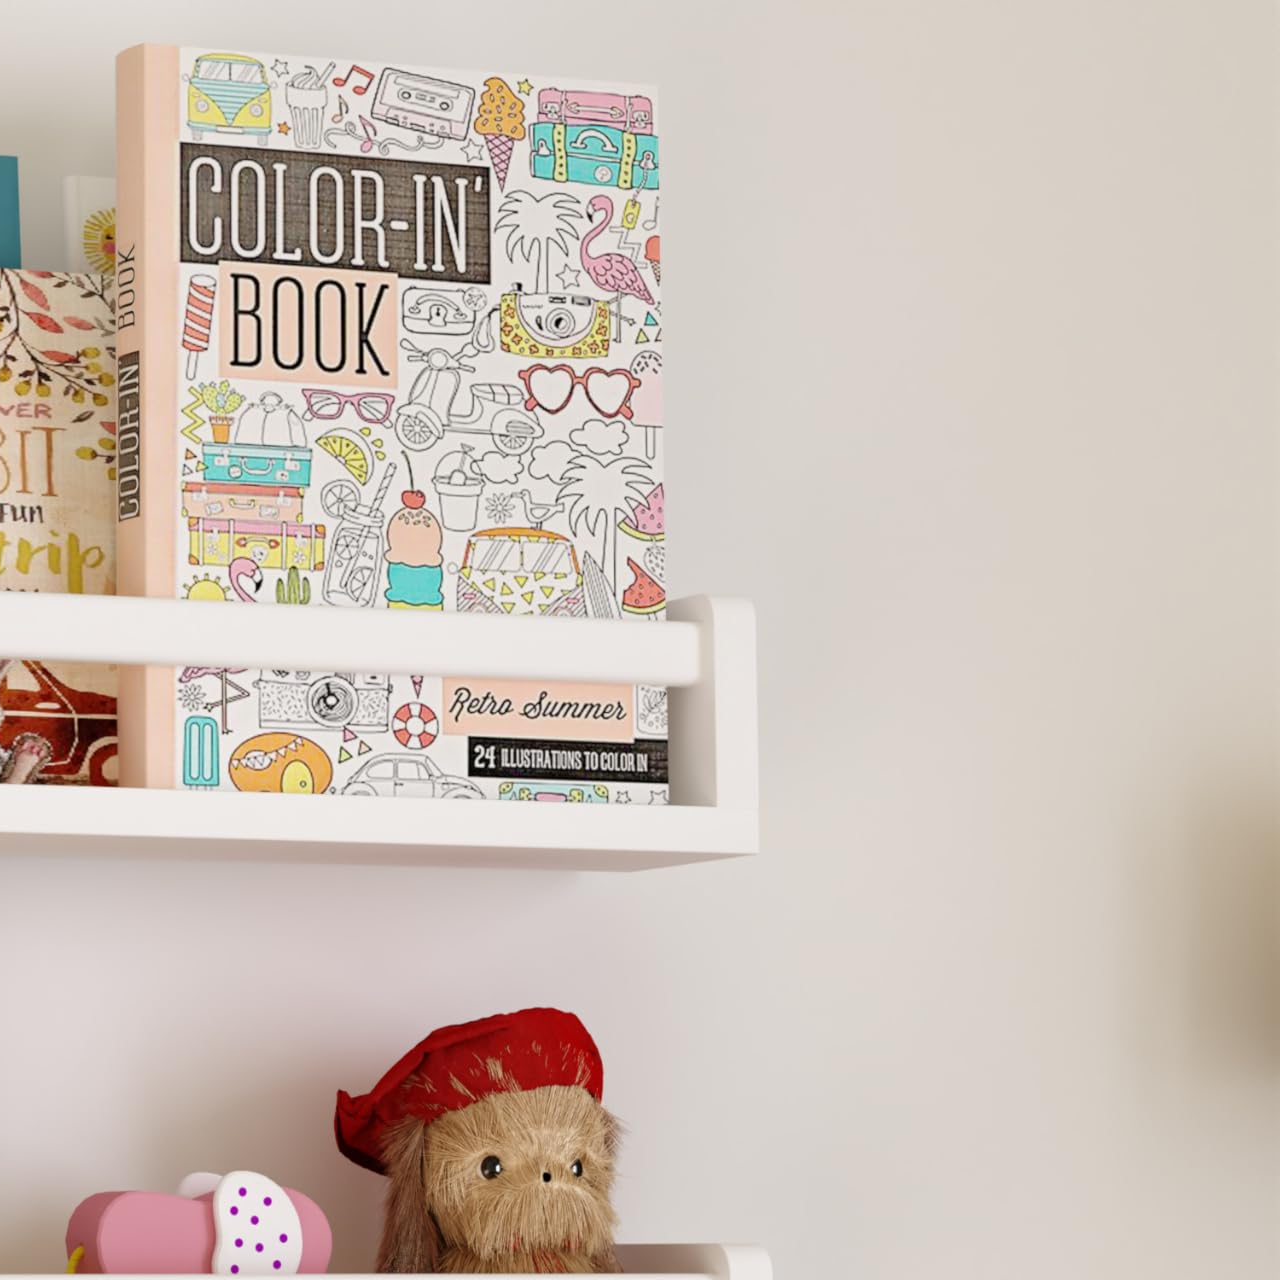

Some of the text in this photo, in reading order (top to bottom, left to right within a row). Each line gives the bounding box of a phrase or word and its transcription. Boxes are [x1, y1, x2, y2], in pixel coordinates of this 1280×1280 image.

[186, 155, 483, 273] COLOR-IN'
[118, 243, 136, 331] BOOK
[229, 272, 390, 376] BOOK
[449, 687, 627, 723] Retro Summer
[474, 744, 648, 772] 24 ILLUSTRATIONS TO COLOR IN
